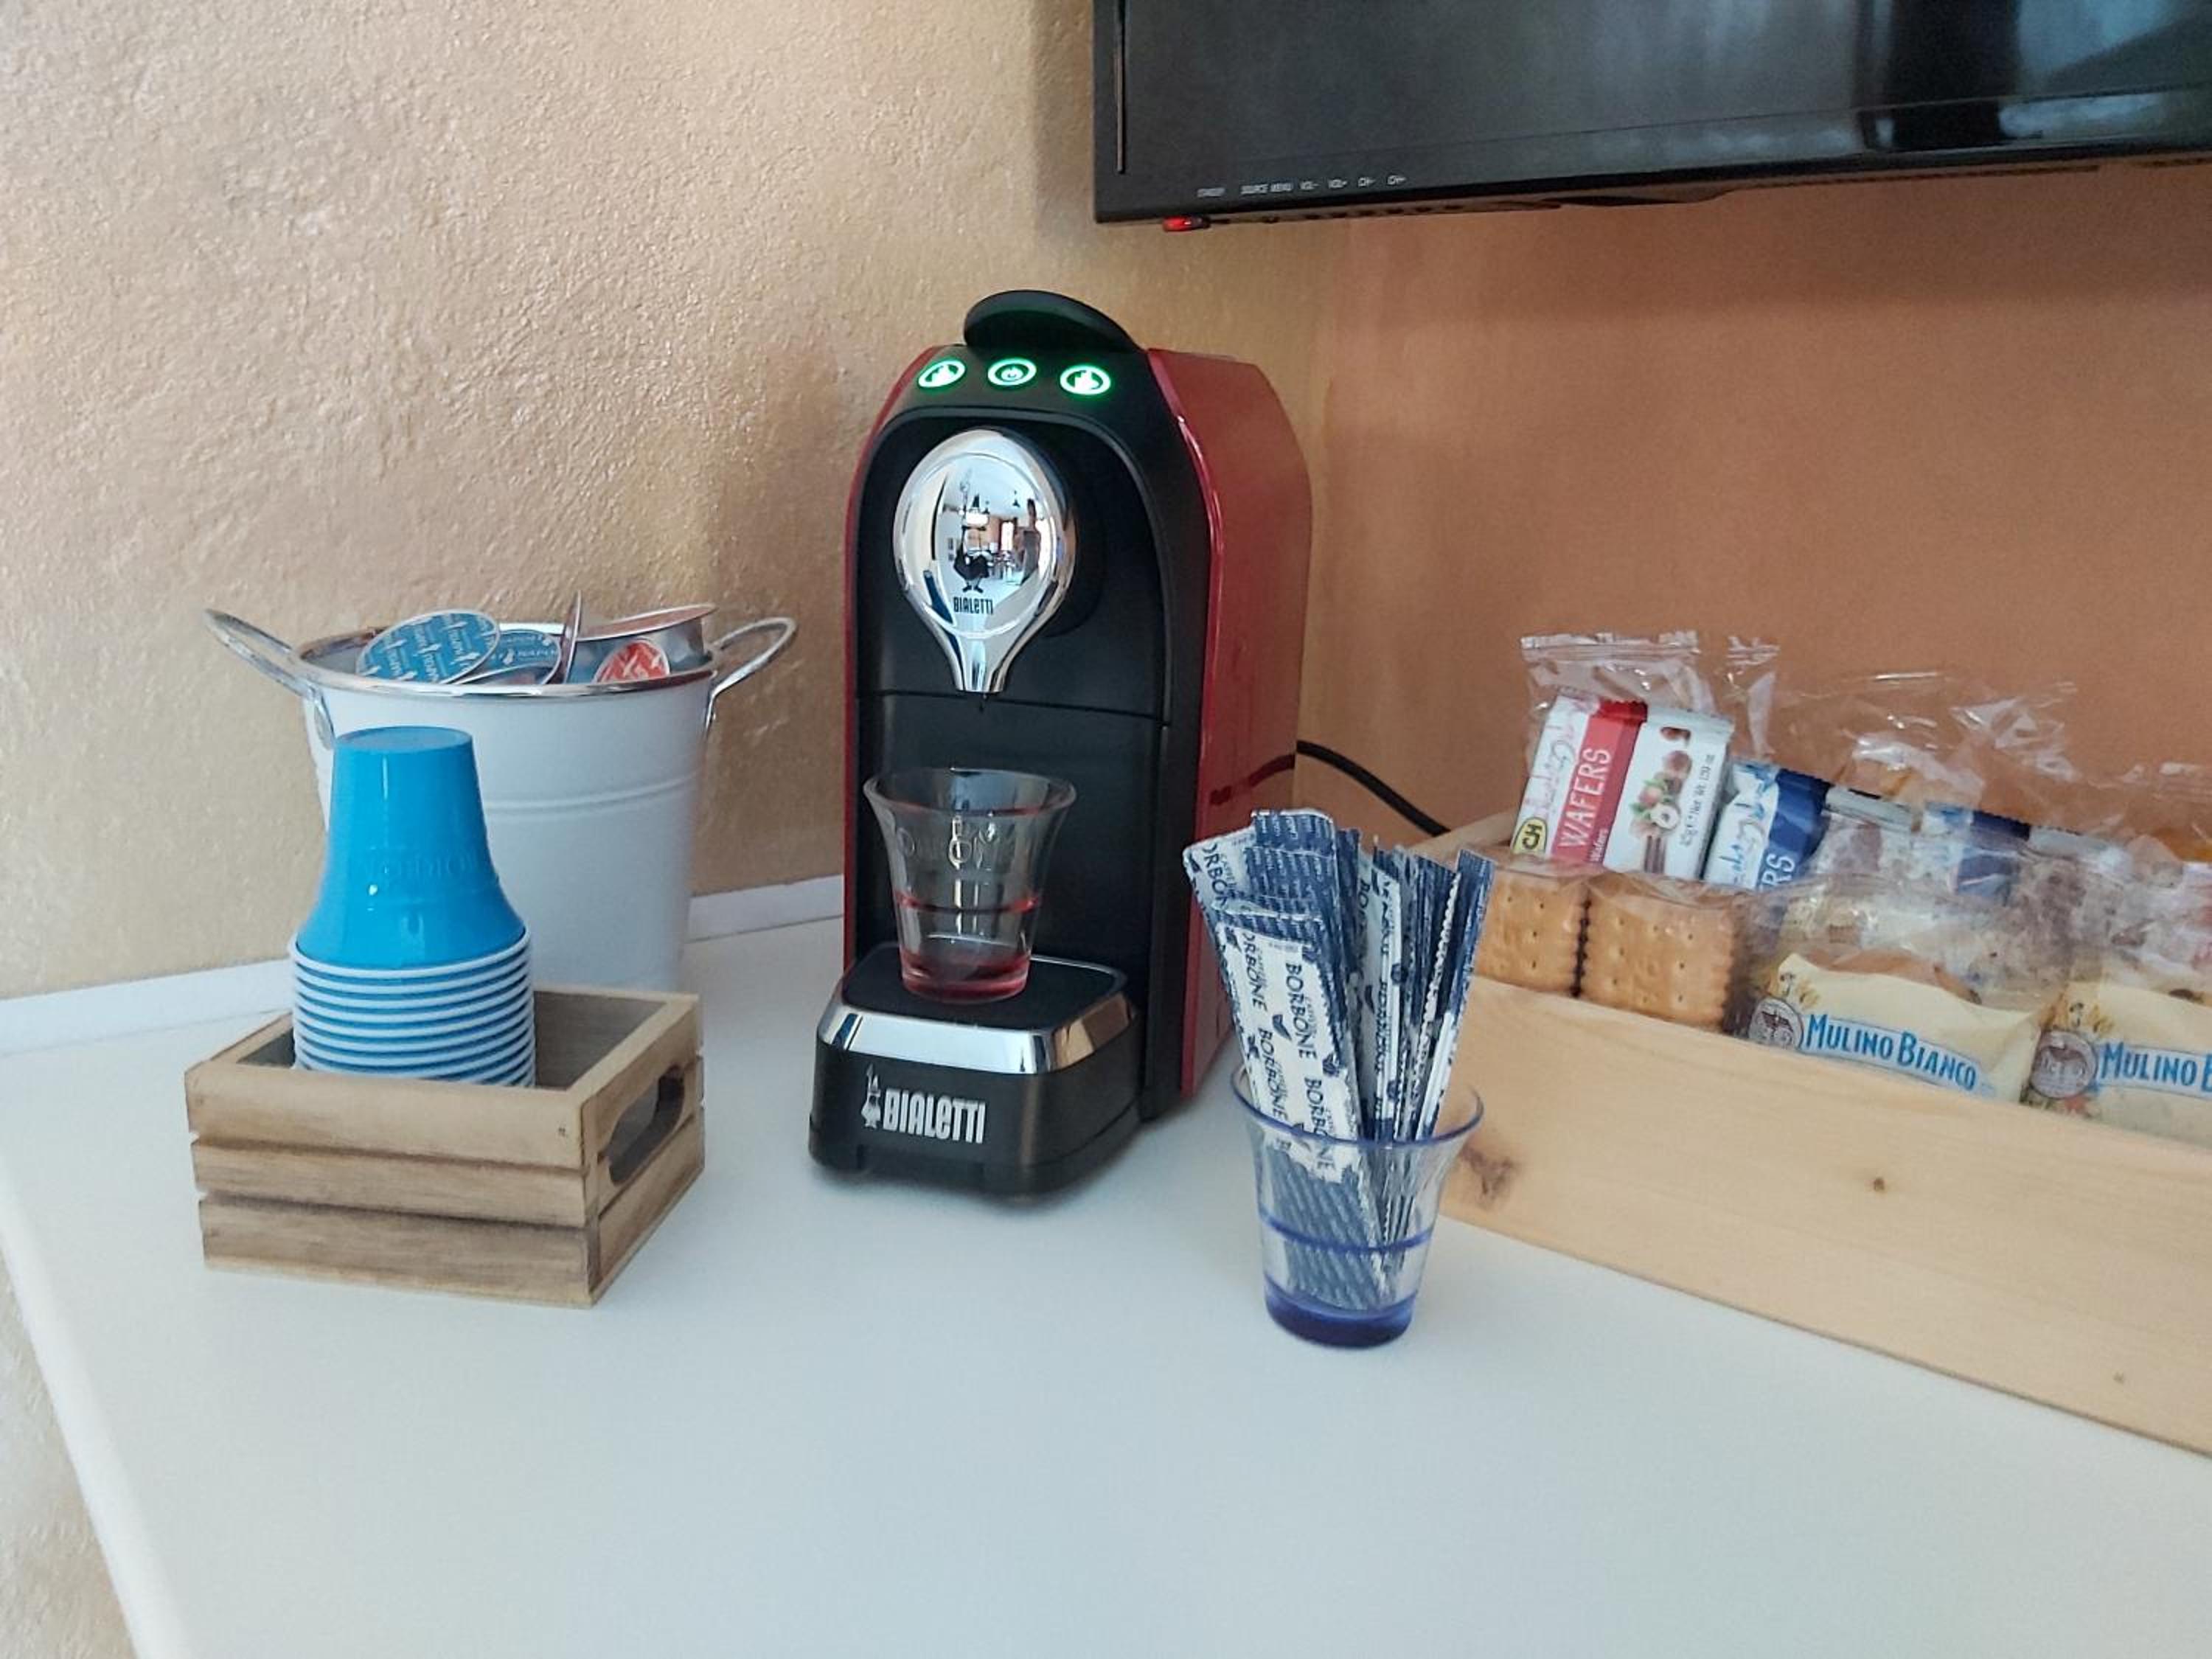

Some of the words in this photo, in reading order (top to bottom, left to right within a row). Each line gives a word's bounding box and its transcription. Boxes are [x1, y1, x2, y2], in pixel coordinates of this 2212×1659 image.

[1558, 748, 1611, 849] WAFERS
[1285, 961, 1317, 1060] BORBONE
[1806, 1014, 1893, 1060] MULINO
[1897, 1032, 1976, 1091] BIANCO
[1258, 1027, 1287, 1119] BORBONE
[2101, 1041, 2198, 1086] MULINO
[883, 1087, 987, 1144] BIALETTI
